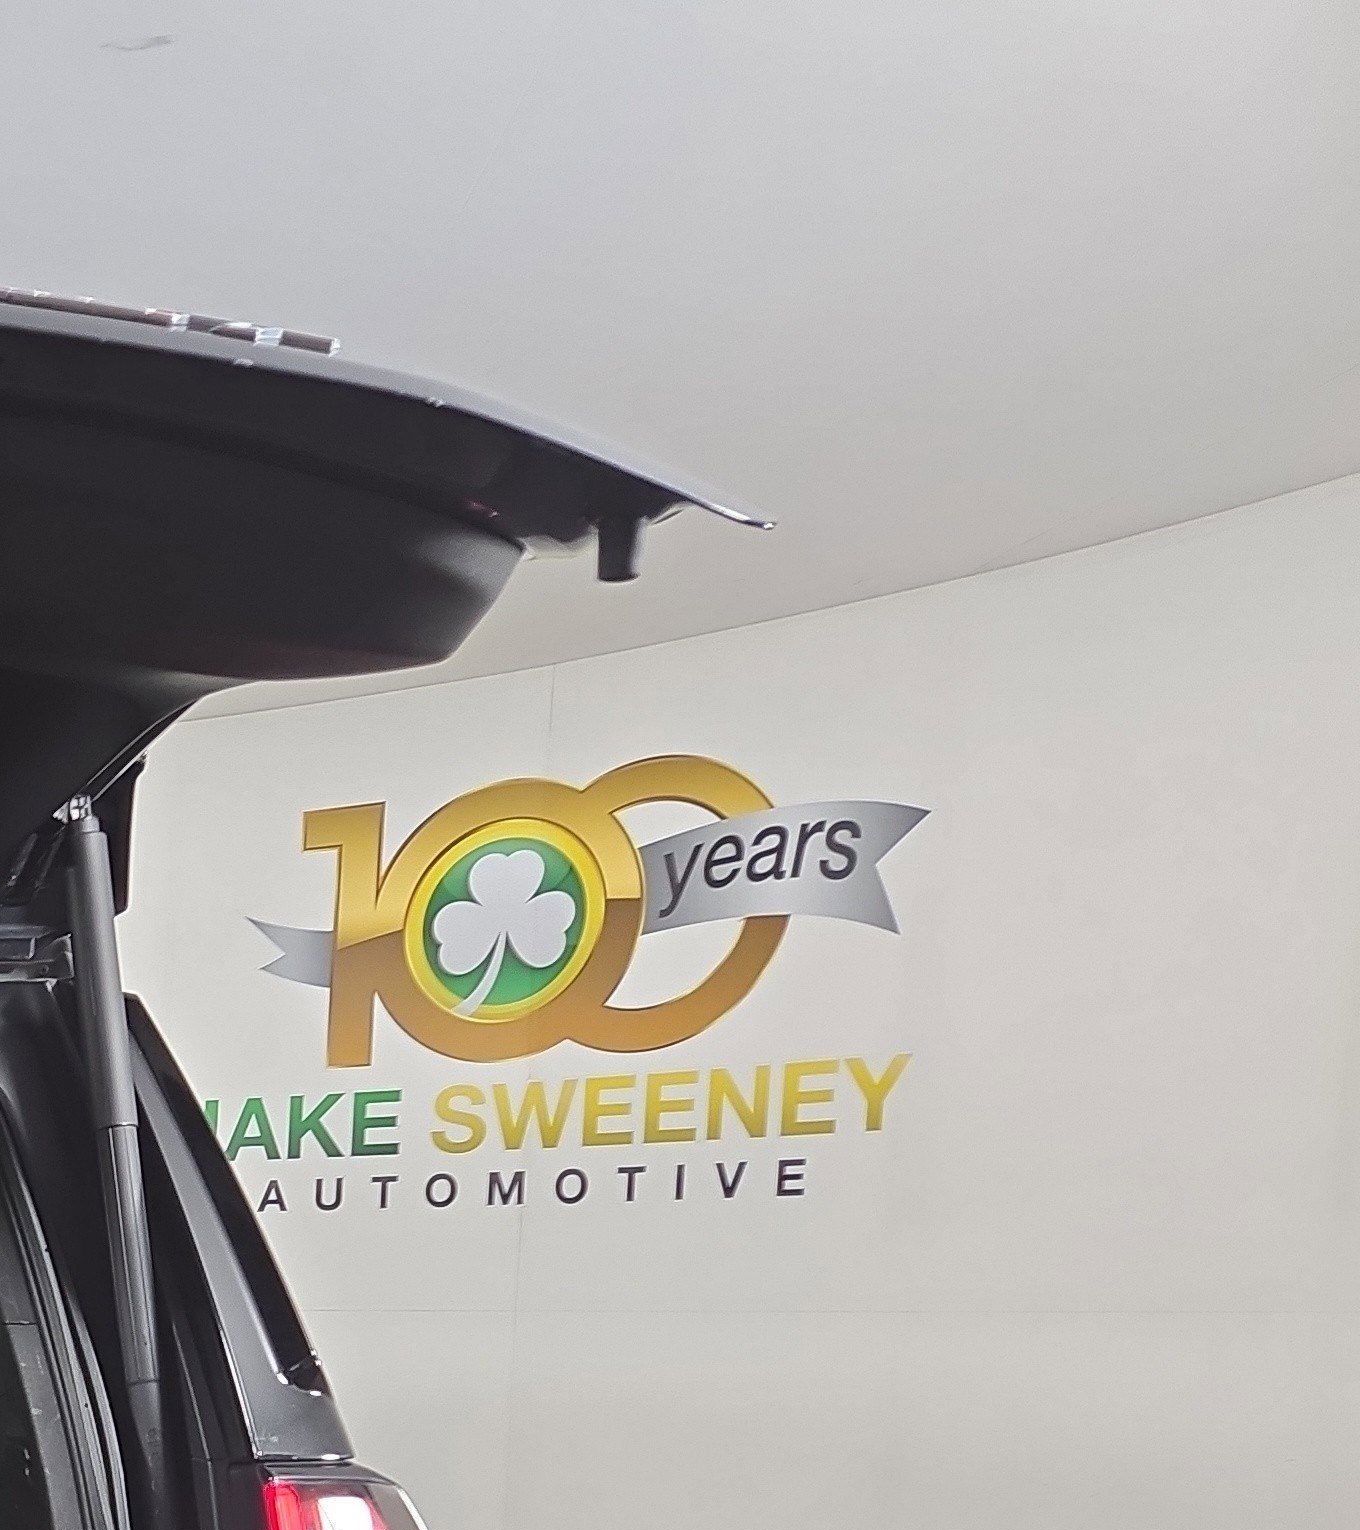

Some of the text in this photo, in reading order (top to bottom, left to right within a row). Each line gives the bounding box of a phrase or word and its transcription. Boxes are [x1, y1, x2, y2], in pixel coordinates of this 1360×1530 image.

[658, 819, 862, 918] years
[429, 1053, 912, 1155] SWEENEY
[256, 1158, 807, 1213] AUTOMOTIVE
